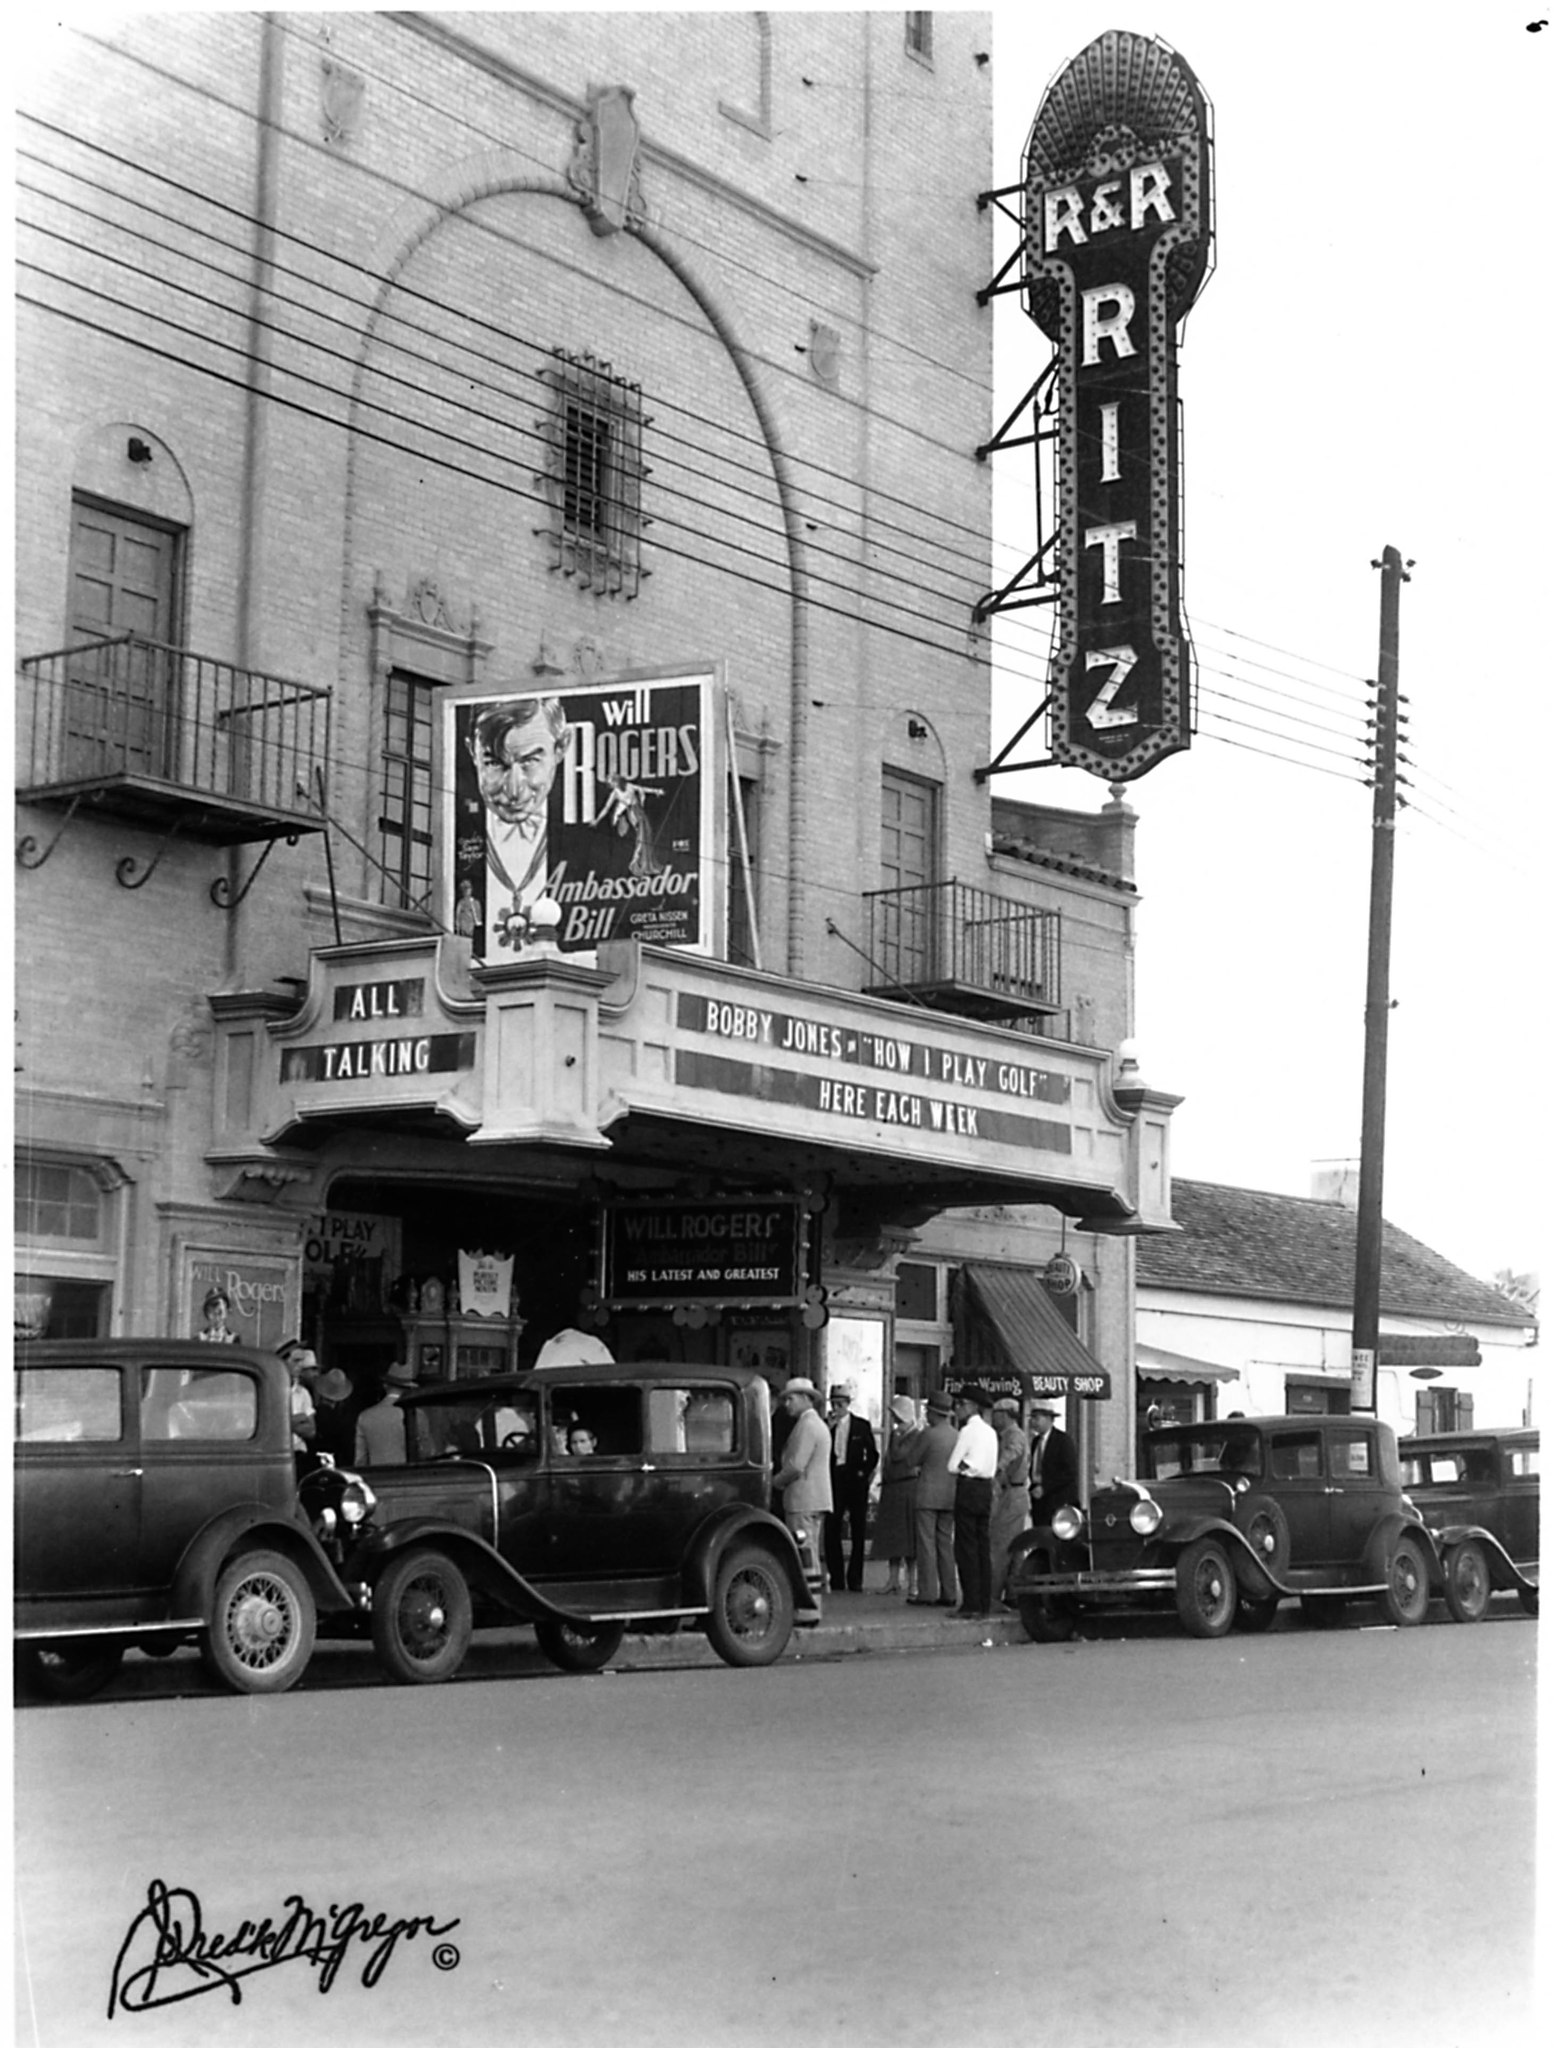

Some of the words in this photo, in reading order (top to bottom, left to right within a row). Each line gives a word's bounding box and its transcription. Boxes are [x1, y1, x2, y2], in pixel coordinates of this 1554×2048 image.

[1044, 161, 1176, 253] R&R
[1081, 282, 1138, 731] RITZ
[602, 688, 650, 727] Will
[563, 721, 699, 824] ROGERS
[536, 860, 698, 902] Ambassador
[563, 905, 616, 942] Bill
[350, 985, 400, 1019] ALL
[324, 1039, 430, 1078] TALKING
[707, 1001, 772, 1043] BOBBY
[782, 1018, 842, 1058] JONES
[924, 1048, 930, 1075] I
[942, 1054, 987, 1087] PLAY
[819, 1080, 867, 1116] HERE
[876, 1090, 921, 1125] EACH
[929, 1100, 979, 1136] WEEK
[332, 1218, 377, 1241] PLAY
[624, 1215, 677, 1240] WILL
[682, 1212, 781, 1240] ROGERS
[627, 1269, 647, 1282] HIS
[651, 1268, 694, 1281] LATEST
[696, 1268, 721, 1281] AND
[723, 1267, 780, 1280] GREATEST
[1032, 1375, 1069, 1392] BEAUTY
[1074, 1376, 1104, 1393] SHOP
